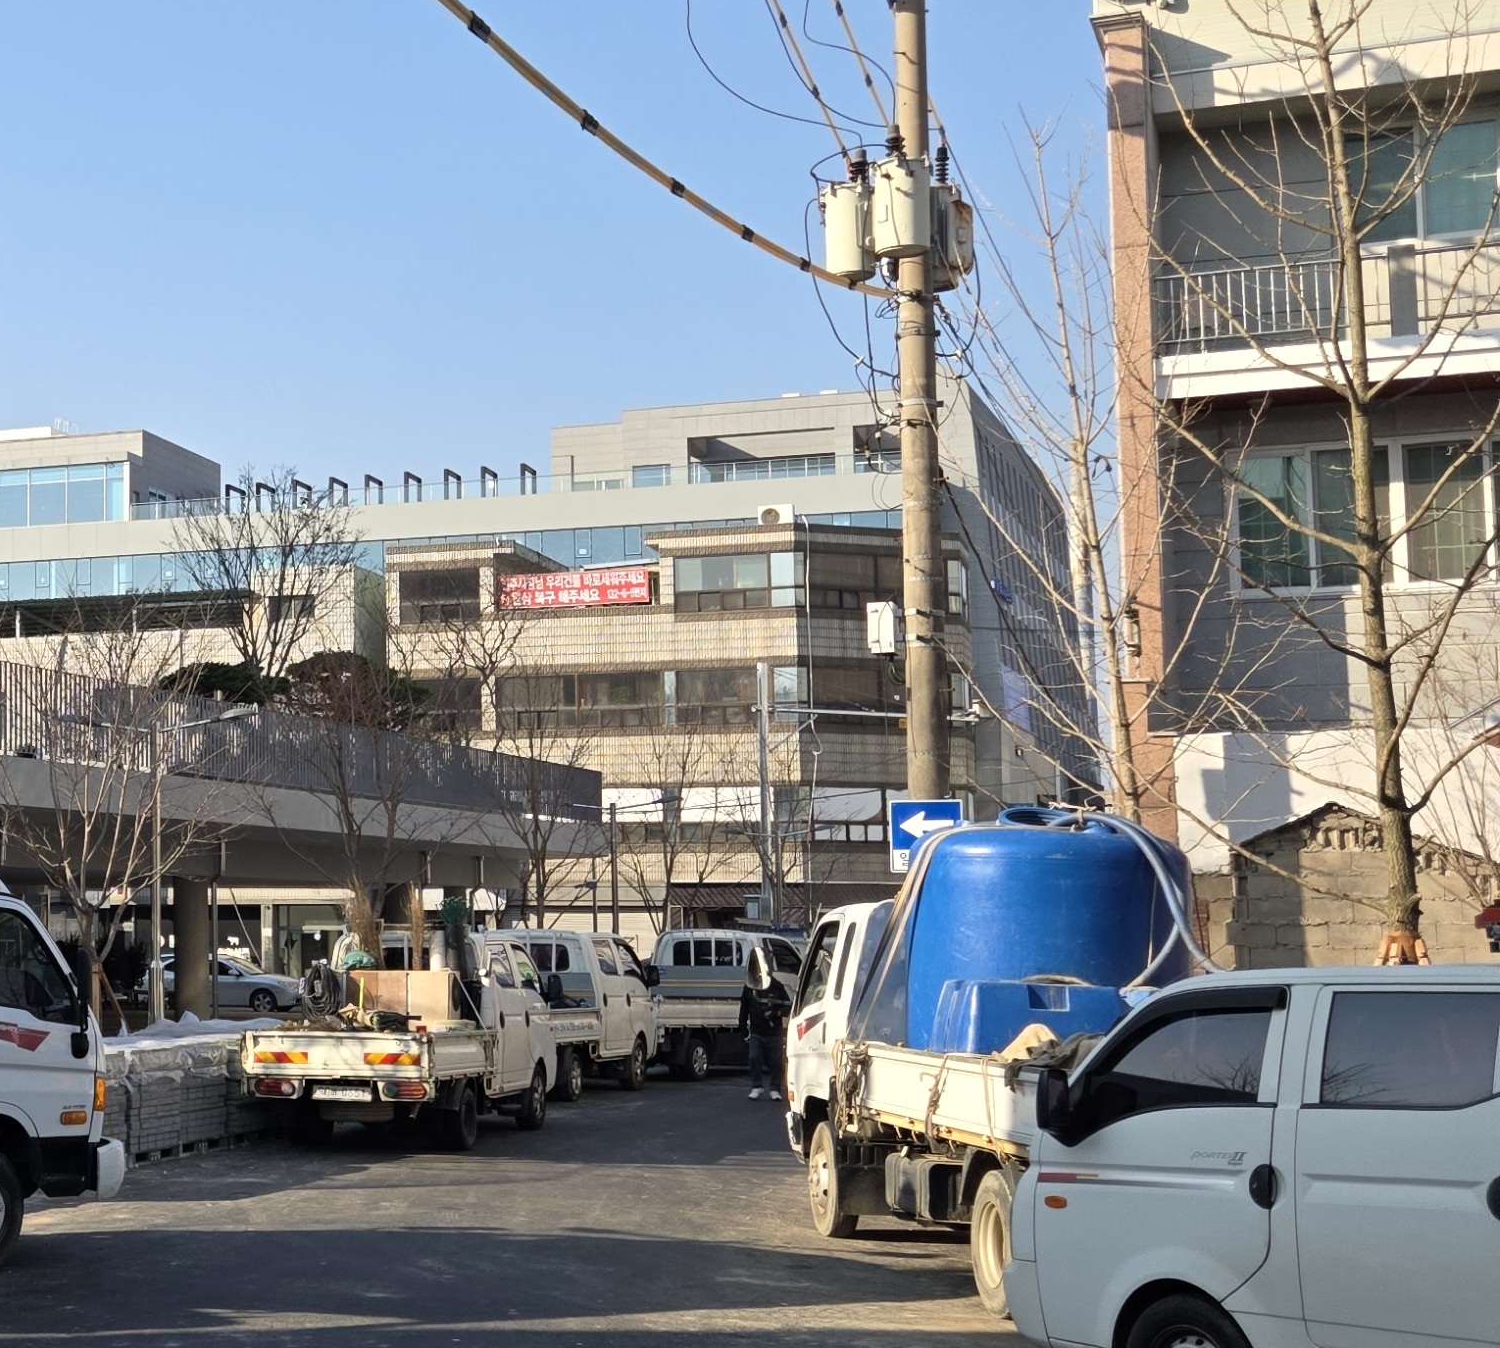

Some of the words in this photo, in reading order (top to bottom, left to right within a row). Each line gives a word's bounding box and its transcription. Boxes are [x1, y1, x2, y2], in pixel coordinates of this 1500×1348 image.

[545, 573, 581, 589] 우리건물
[534, 590, 556, 605] 복구
[558, 588, 601, 603] 해주세요
